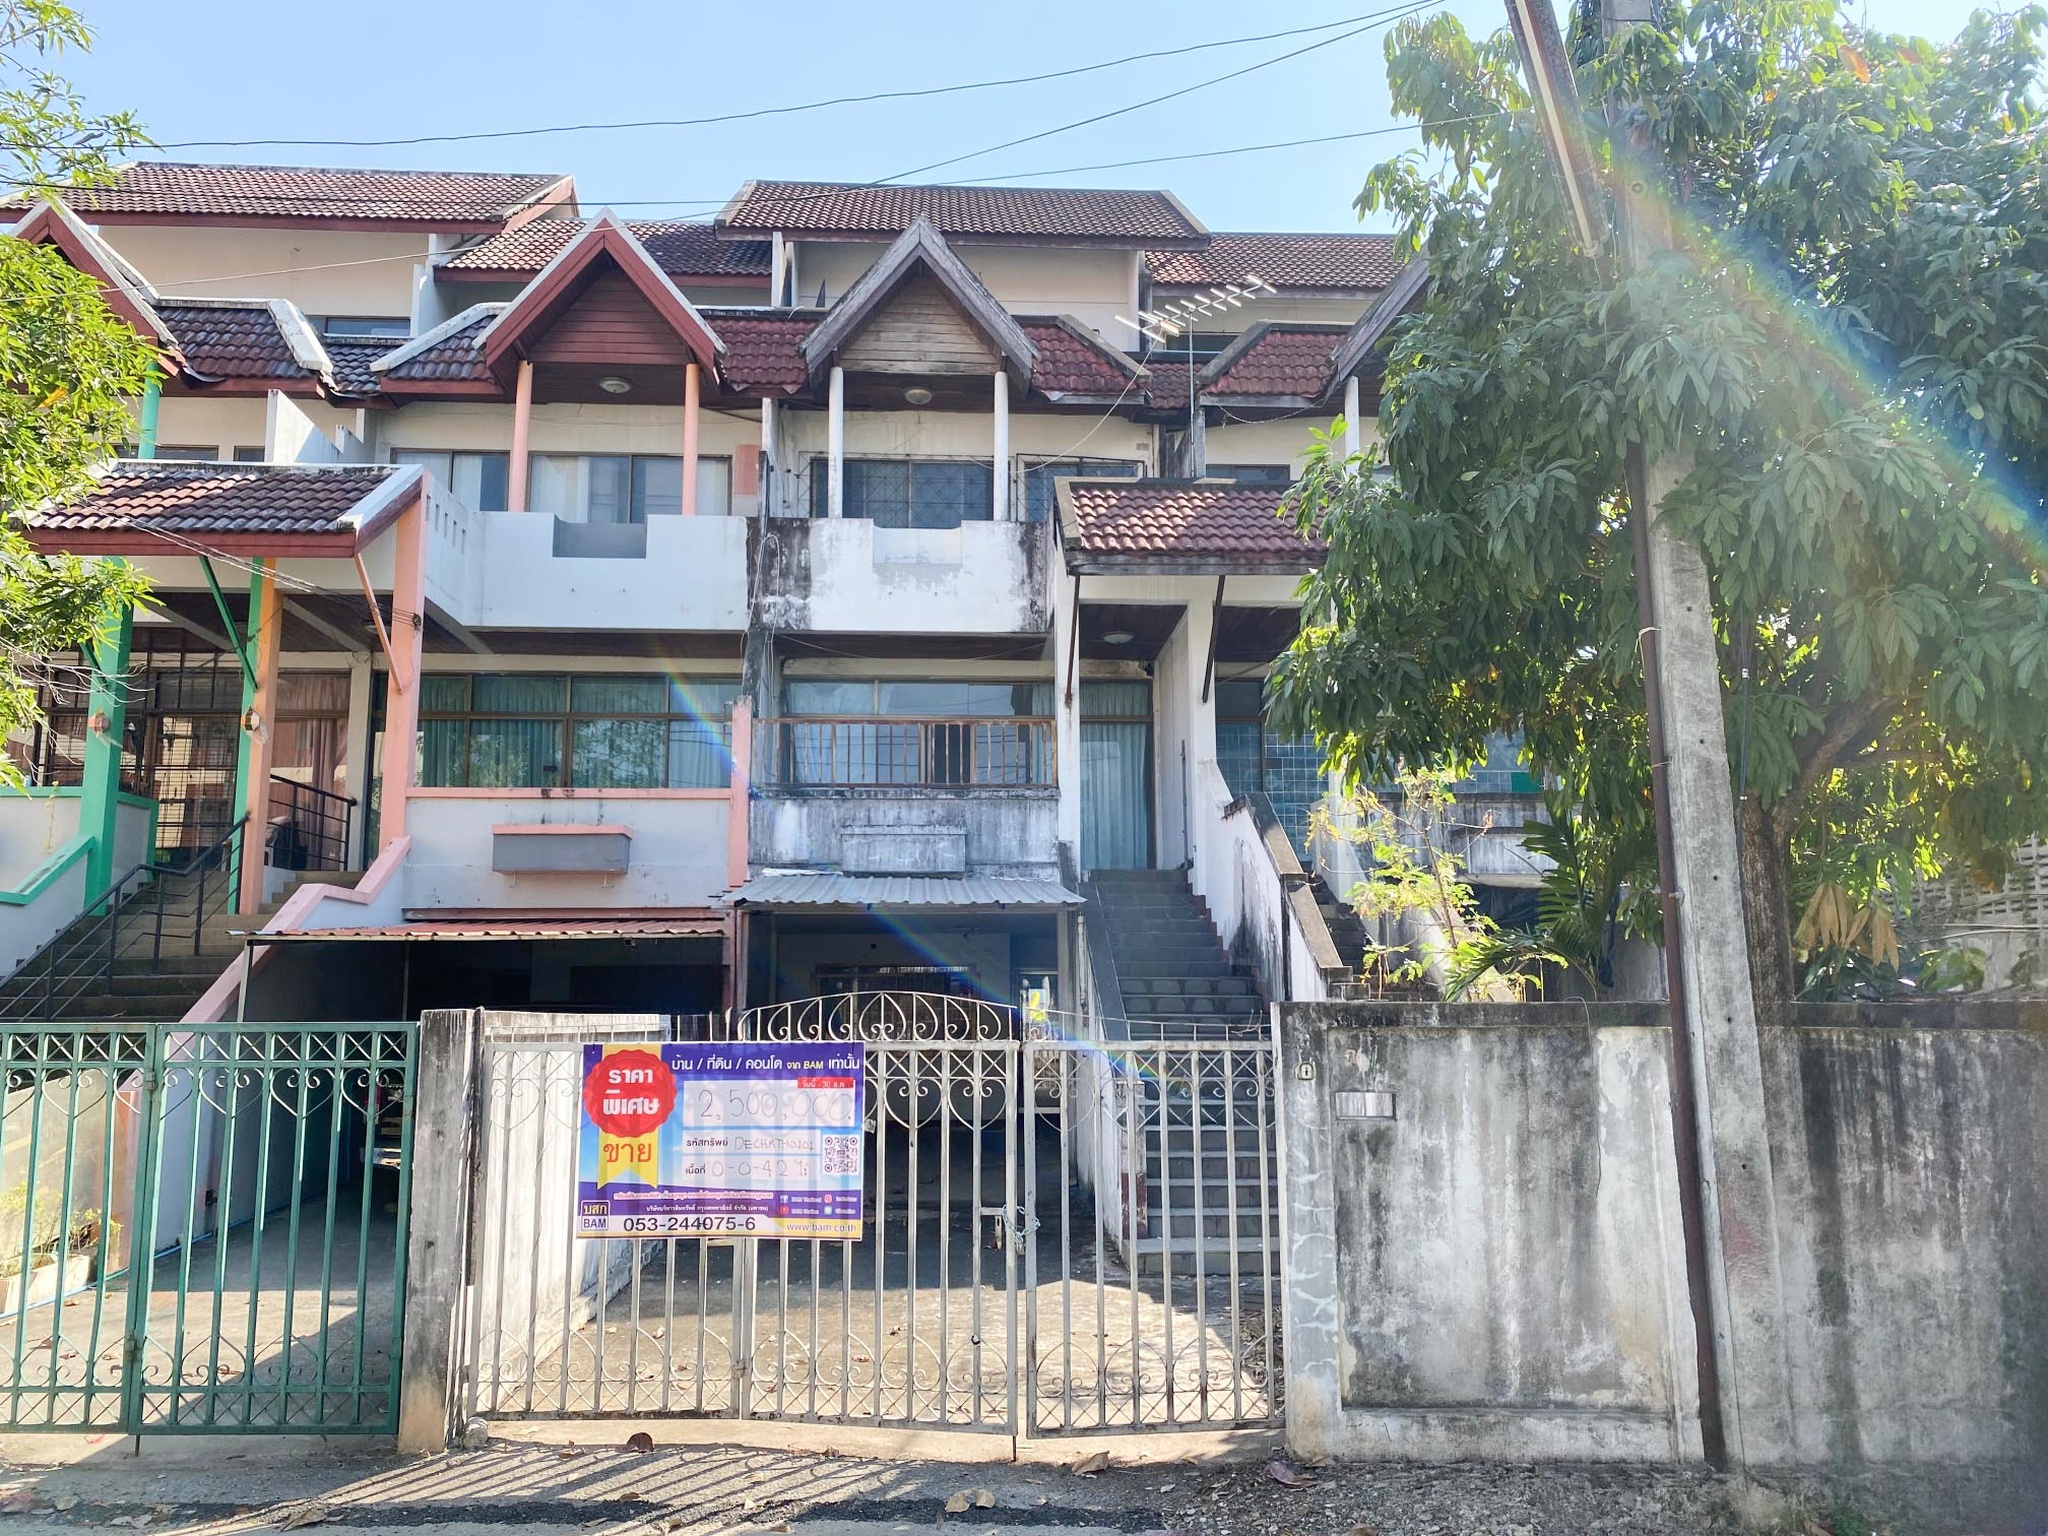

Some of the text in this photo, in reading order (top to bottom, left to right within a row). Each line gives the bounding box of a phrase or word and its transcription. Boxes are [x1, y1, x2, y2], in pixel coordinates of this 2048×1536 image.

[671, 1053, 860, 1070] บ้าน / ที่ดิน / คอนโด จาก BAM เท่านั้น
[608, 1069, 653, 1084] ราคา
[602, 1089, 660, 1116] พิเศษ
[686, 1137, 729, 1147] รหัสทรัพย์
[603, 1143, 652, 1163] ขาย
[685, 1162, 706, 1175] เนื้อที่
[584, 1204, 607, 1215] บสก
[584, 1218, 606, 1228] BAM
